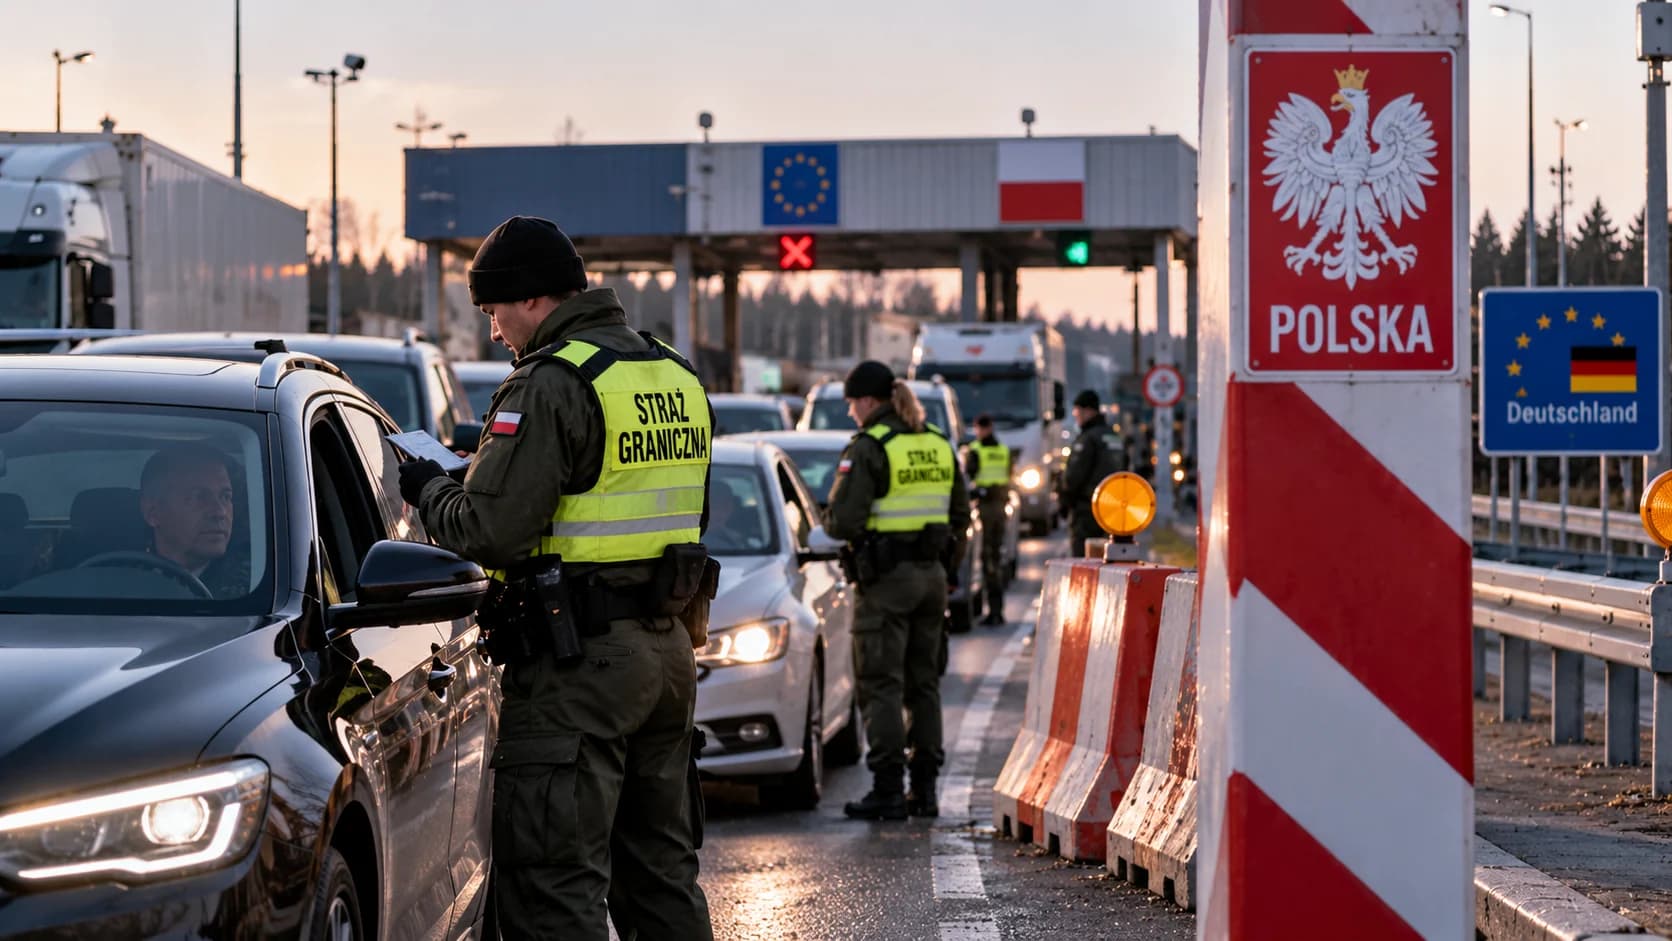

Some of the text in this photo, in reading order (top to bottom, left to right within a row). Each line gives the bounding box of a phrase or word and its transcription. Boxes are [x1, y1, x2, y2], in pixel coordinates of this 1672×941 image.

[1270, 304, 1434, 354] POLSKA
[634, 387, 690, 425] STRAŻ
[1507, 400, 1638, 424] Deutschland
[618, 427, 708, 464] GRANICZNA
